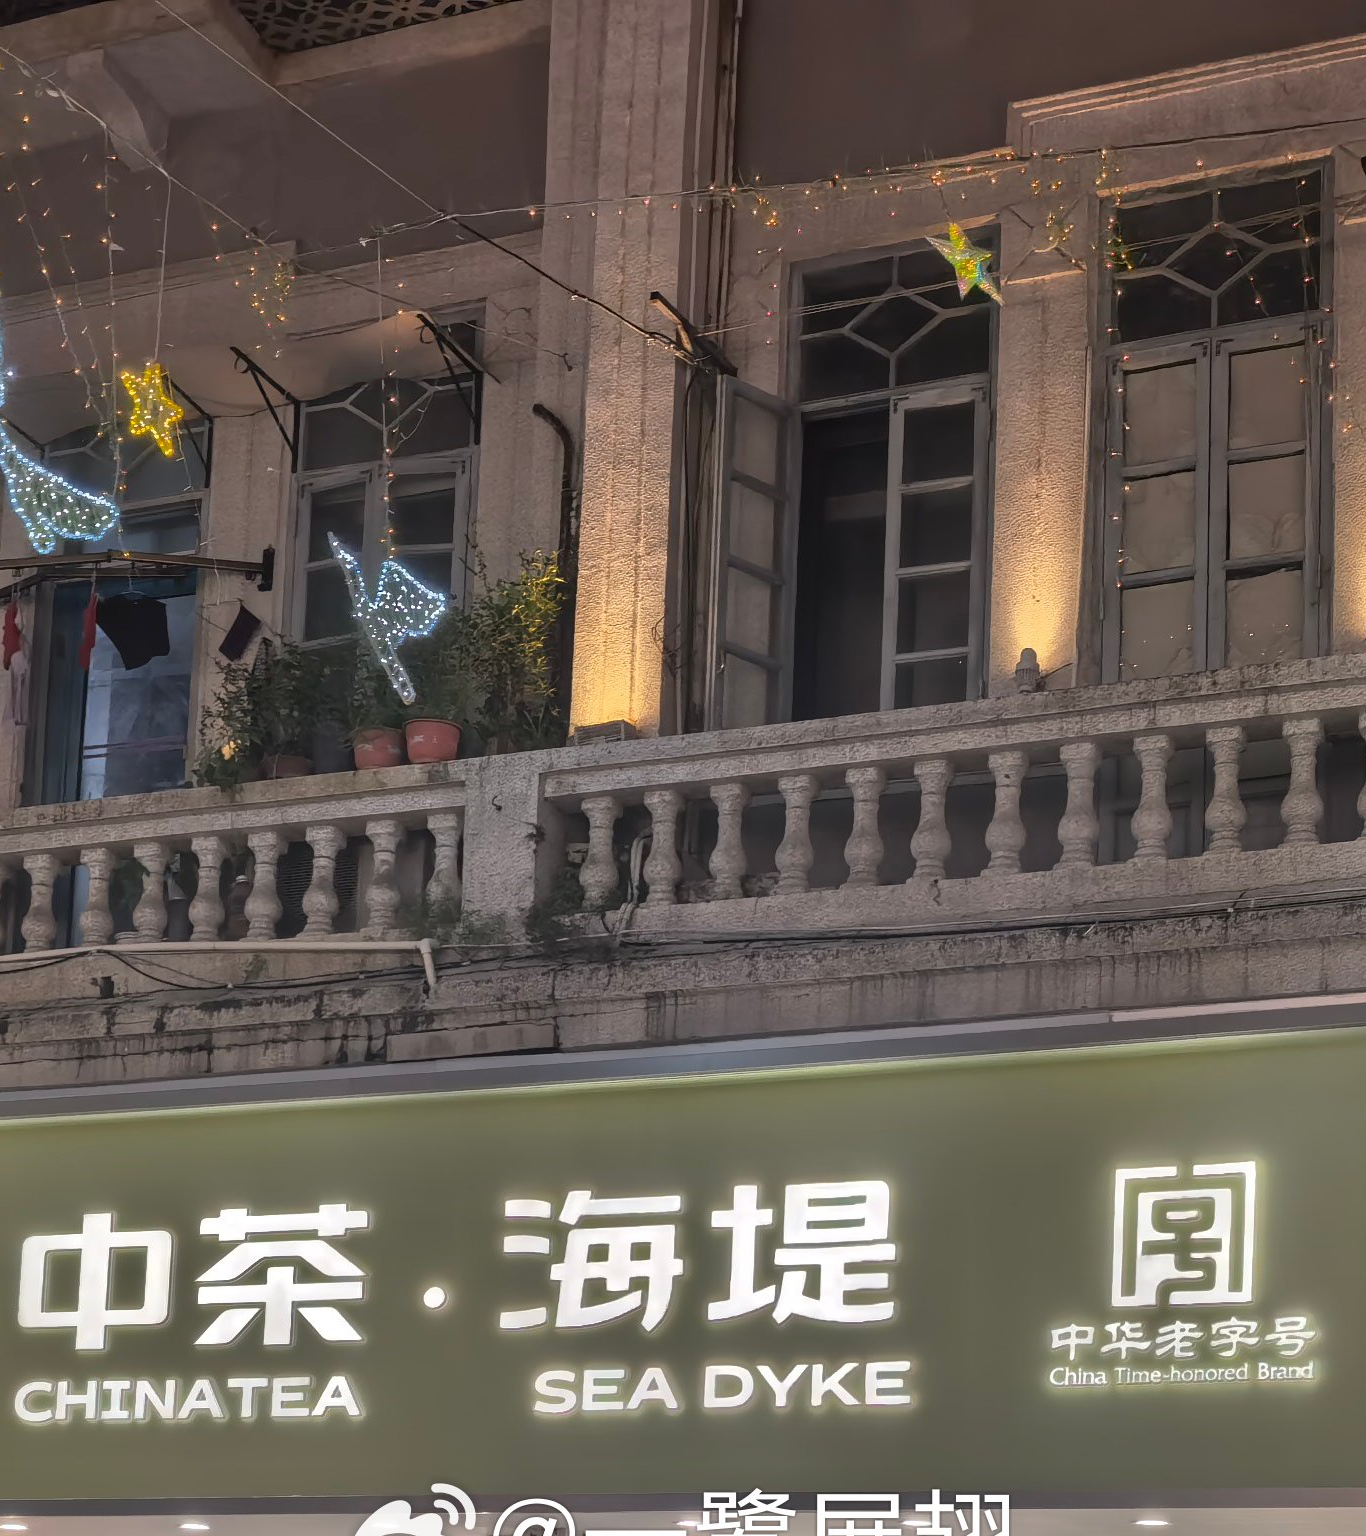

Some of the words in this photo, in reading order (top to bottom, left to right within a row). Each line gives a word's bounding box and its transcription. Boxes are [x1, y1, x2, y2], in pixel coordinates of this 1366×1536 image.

[1051, 1316, 1316, 1361] 中华老字号
[14, 1375, 364, 1423] CHINATEA
[533, 1367, 680, 1416] SEA
[702, 1360, 913, 1411] DYKE
[1050, 1366, 1108, 1387] China
[1114, 1363, 1249, 1385] Time-honored
[1258, 1360, 1315, 1381] Brand
